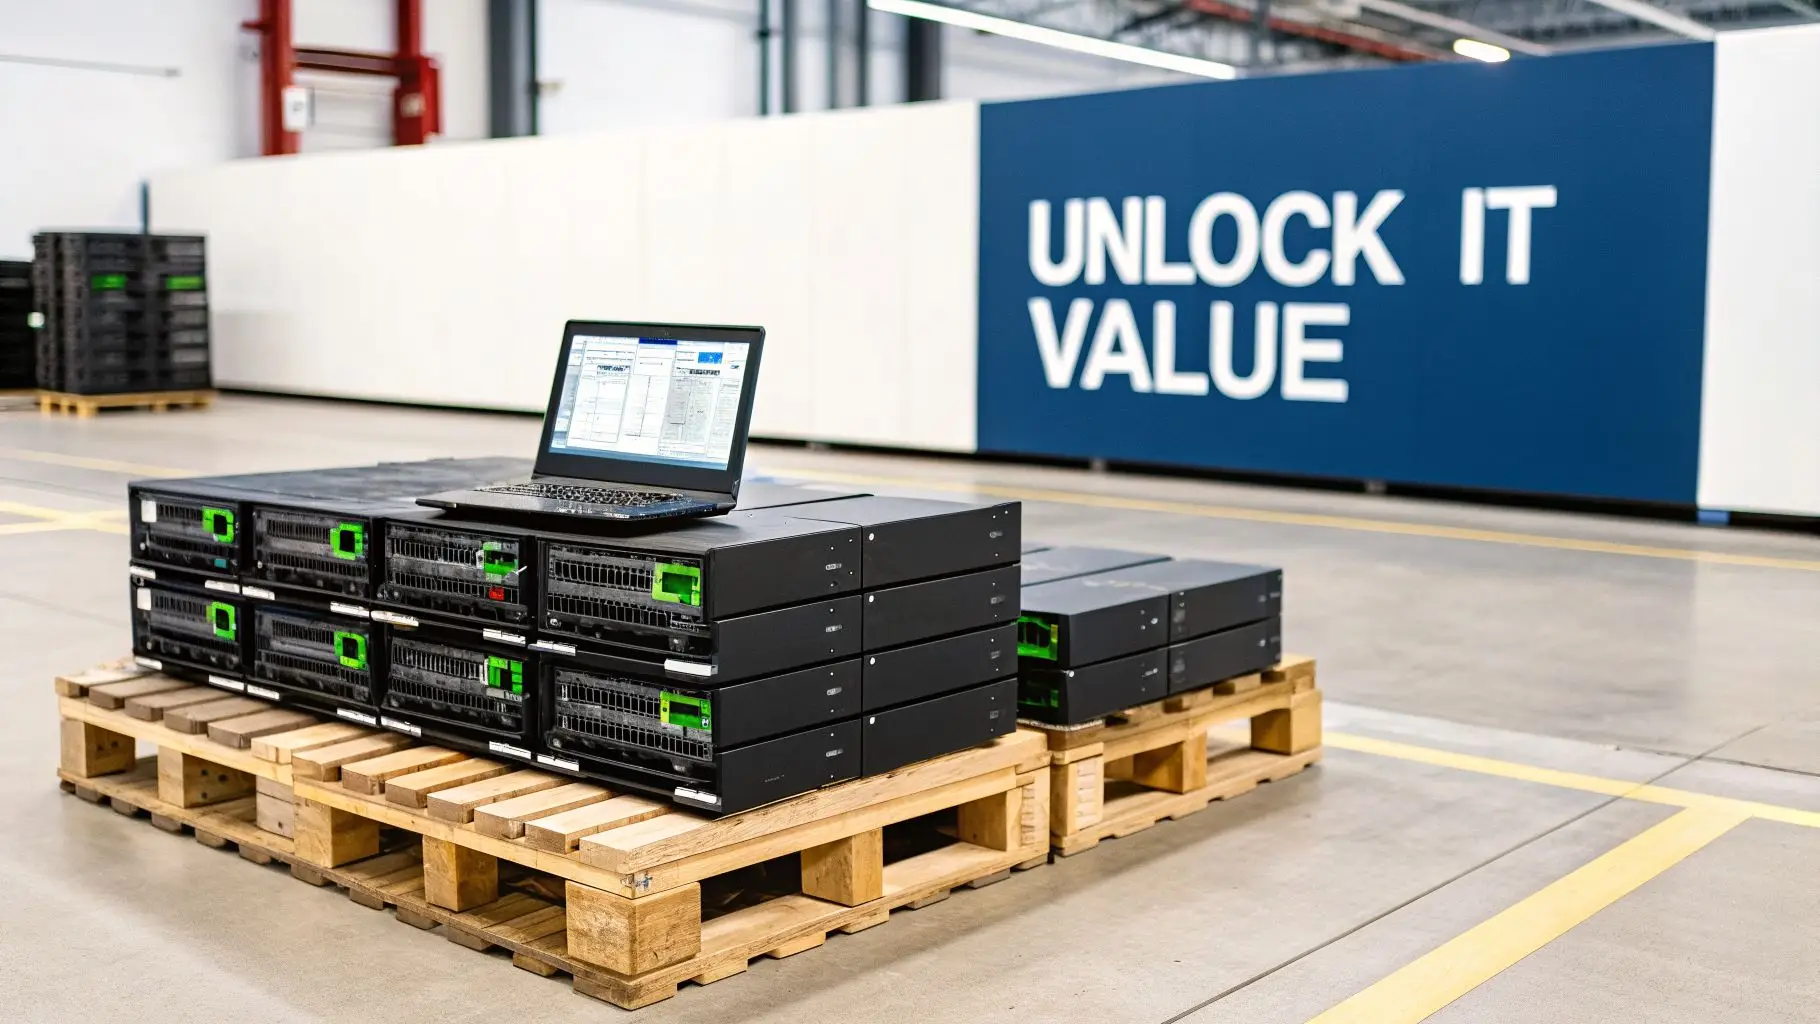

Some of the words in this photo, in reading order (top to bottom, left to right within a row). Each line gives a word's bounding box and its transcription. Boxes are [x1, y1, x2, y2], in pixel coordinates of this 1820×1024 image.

[1029, 189, 1405, 287] UNLOCK
[1460, 185, 1557, 285] IT
[1029, 298, 1350, 403] VALUE
